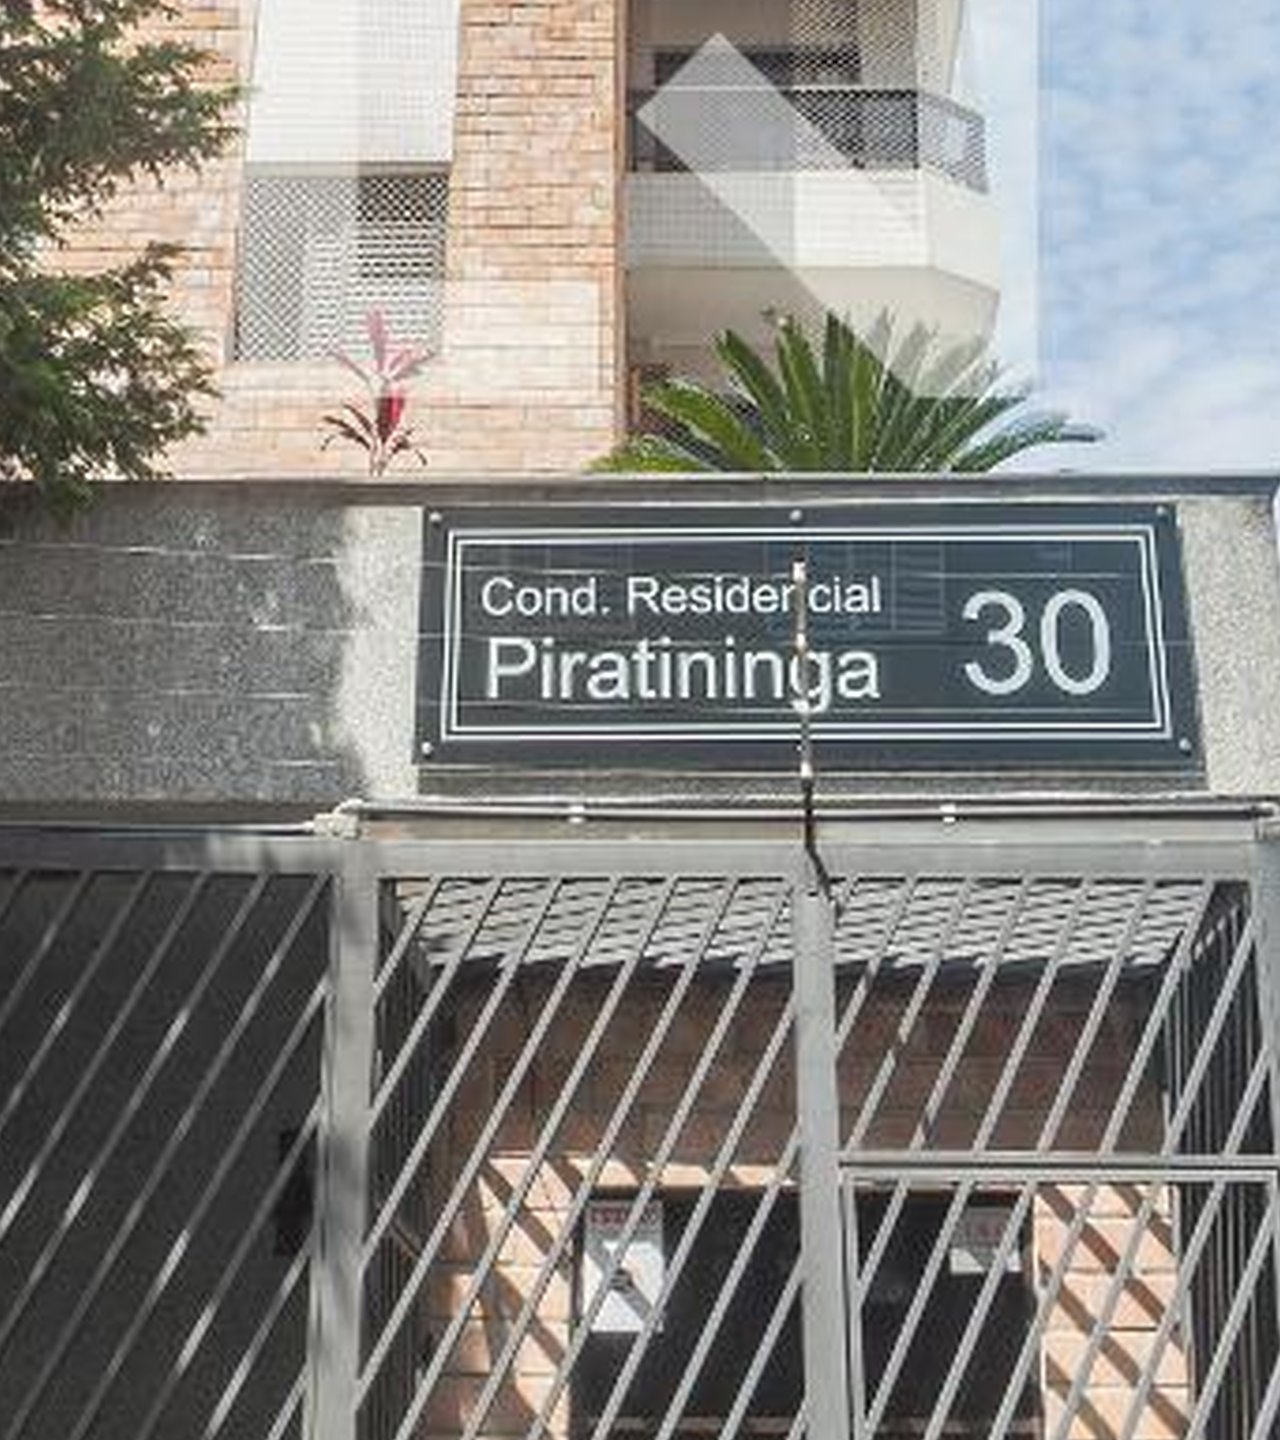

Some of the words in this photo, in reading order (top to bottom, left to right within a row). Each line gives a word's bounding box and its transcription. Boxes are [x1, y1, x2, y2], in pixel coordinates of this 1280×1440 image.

[482, 576, 611, 616] Cond.
[486, 635, 881, 715] Piratininga
[962, 588, 1112, 695] 30
